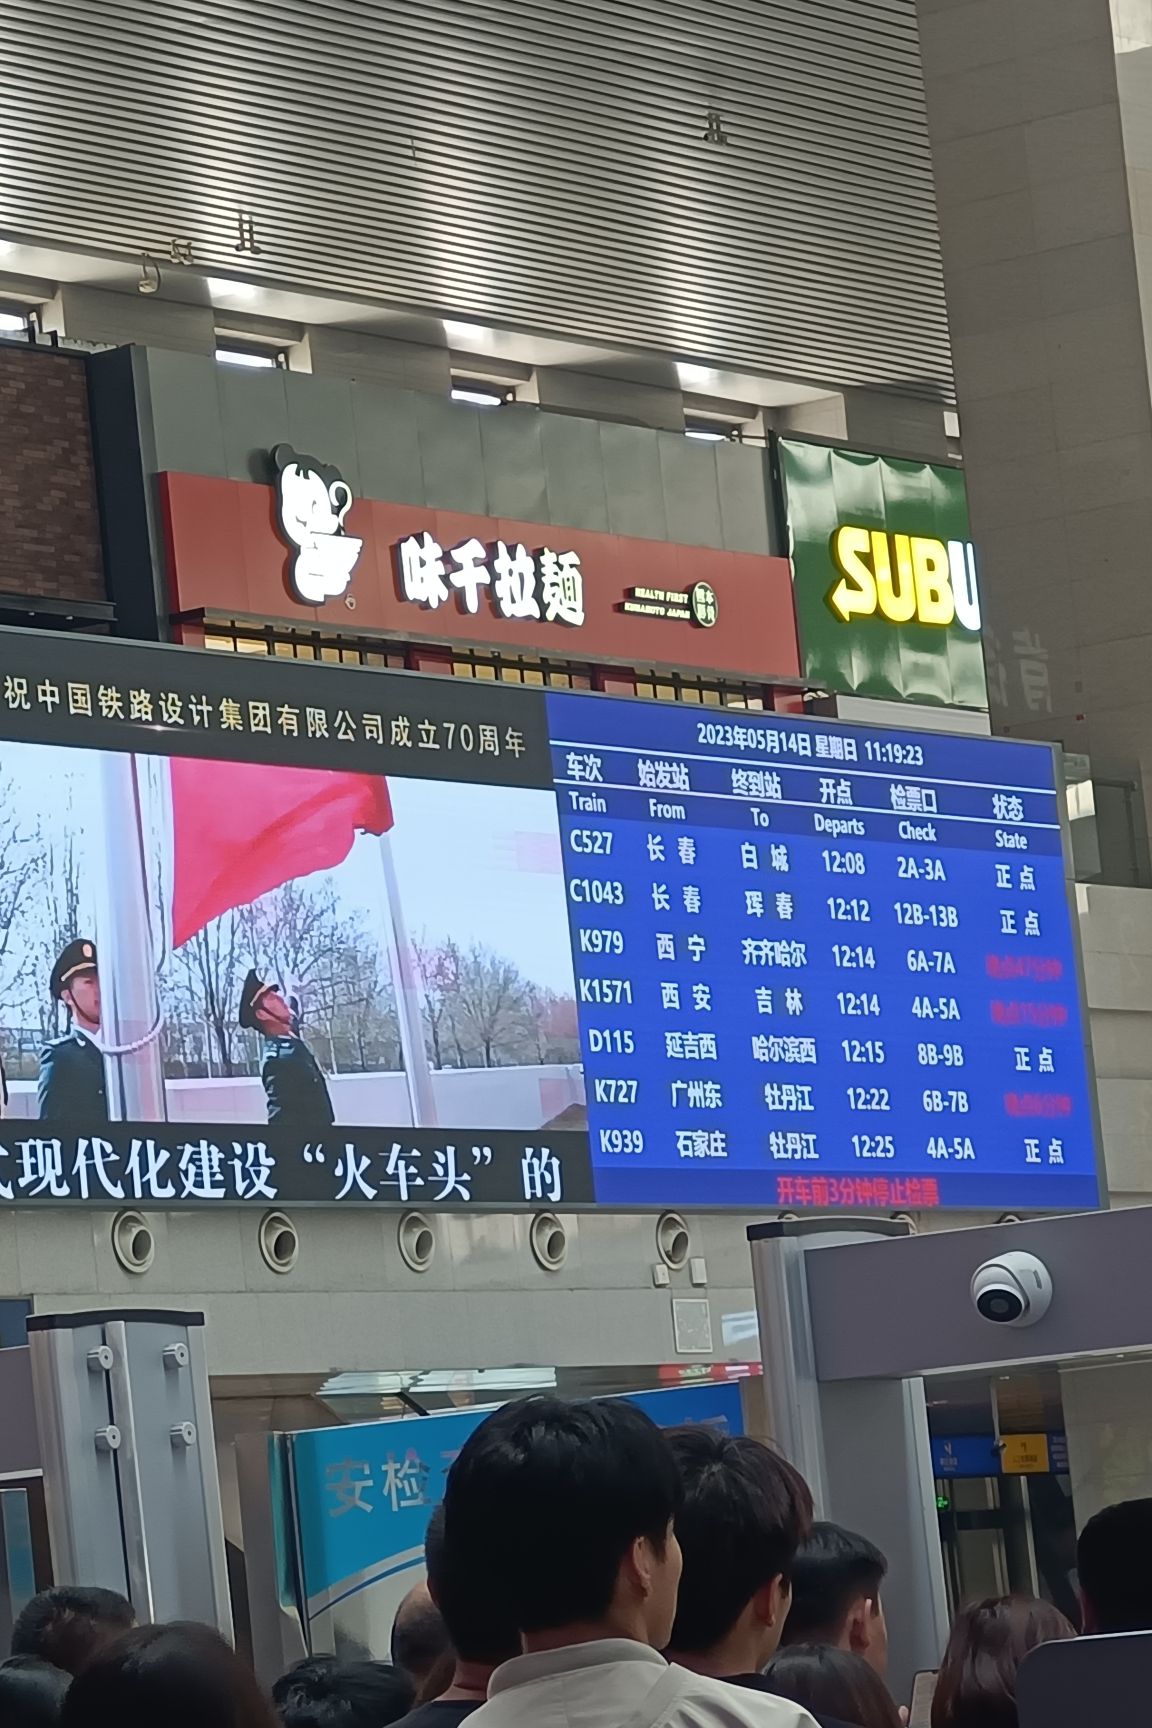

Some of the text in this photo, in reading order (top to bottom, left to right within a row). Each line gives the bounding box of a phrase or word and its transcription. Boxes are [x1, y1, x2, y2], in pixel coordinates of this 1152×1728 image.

[697, 723, 923, 765] 2023年05月14日 星期日 11:19:23
[566, 752, 1024, 821] 车次 始发站 终到站 开点 检票口 状态
[569, 791, 1027, 849] Train From To Departs Check State
[571, 830, 1035, 890] C527 长春 白城 12:08 2A-3A 正点
[570, 879, 1040, 936] C1043 长春 珲春 12:12 12B-13B 正点
[580, 929, 955, 973] K979 西宁 齐齐哈尔 12:14 6A-7A
[580, 979, 960, 1019] K1571 西安 吉林 12:14 4A-5A
[589, 1029, 1054, 1072] D115 延吉西 哈尔滨西 12:15 8B-9B 正点
[595, 1079, 968, 1112] K727 广州东 牡丹江 12:22 6B-7B
[600, 1130, 1063, 1163] K939 石家庄 牡丹江 12:25 4A-5A 正点
[777, 1176, 940, 1207] 开车前3分钟停止检票
[325, 1448, 454, 1516] 安检
